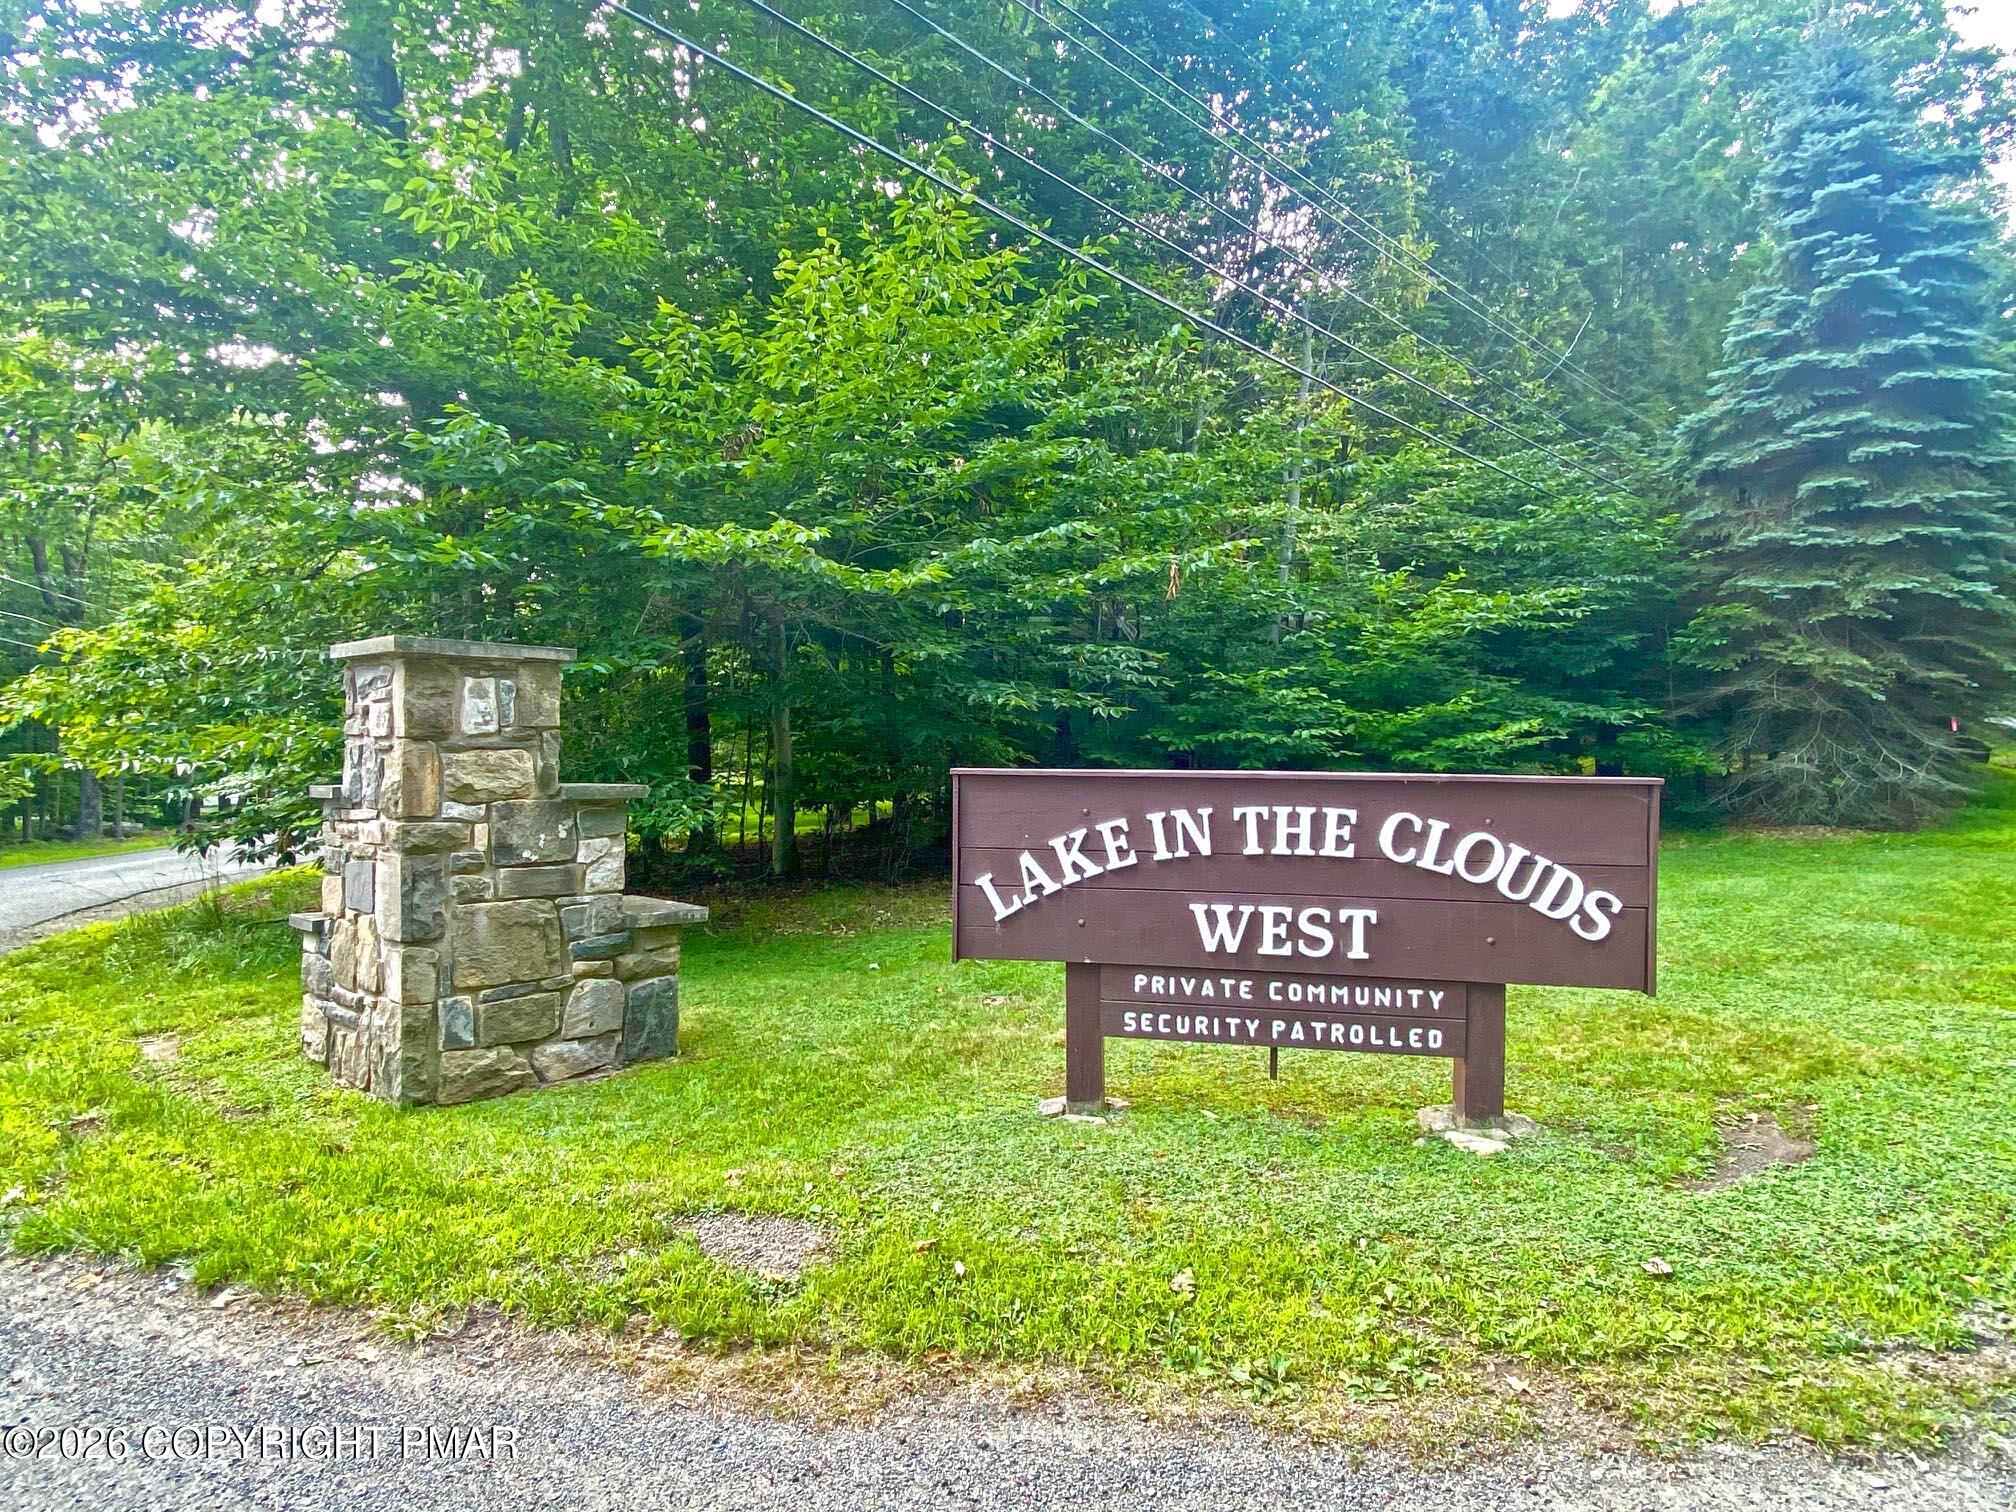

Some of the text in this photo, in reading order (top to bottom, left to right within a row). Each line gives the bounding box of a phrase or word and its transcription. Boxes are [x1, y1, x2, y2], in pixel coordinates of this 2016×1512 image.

[973, 804, 1624, 942] LAKE IN THE CLOUDS
[1188, 902, 1379, 960] WEST
[1133, 973, 1446, 1011] PRIVATE COMMUNITY
[1122, 1011, 1444, 1049] SECURITY PATROLLED
